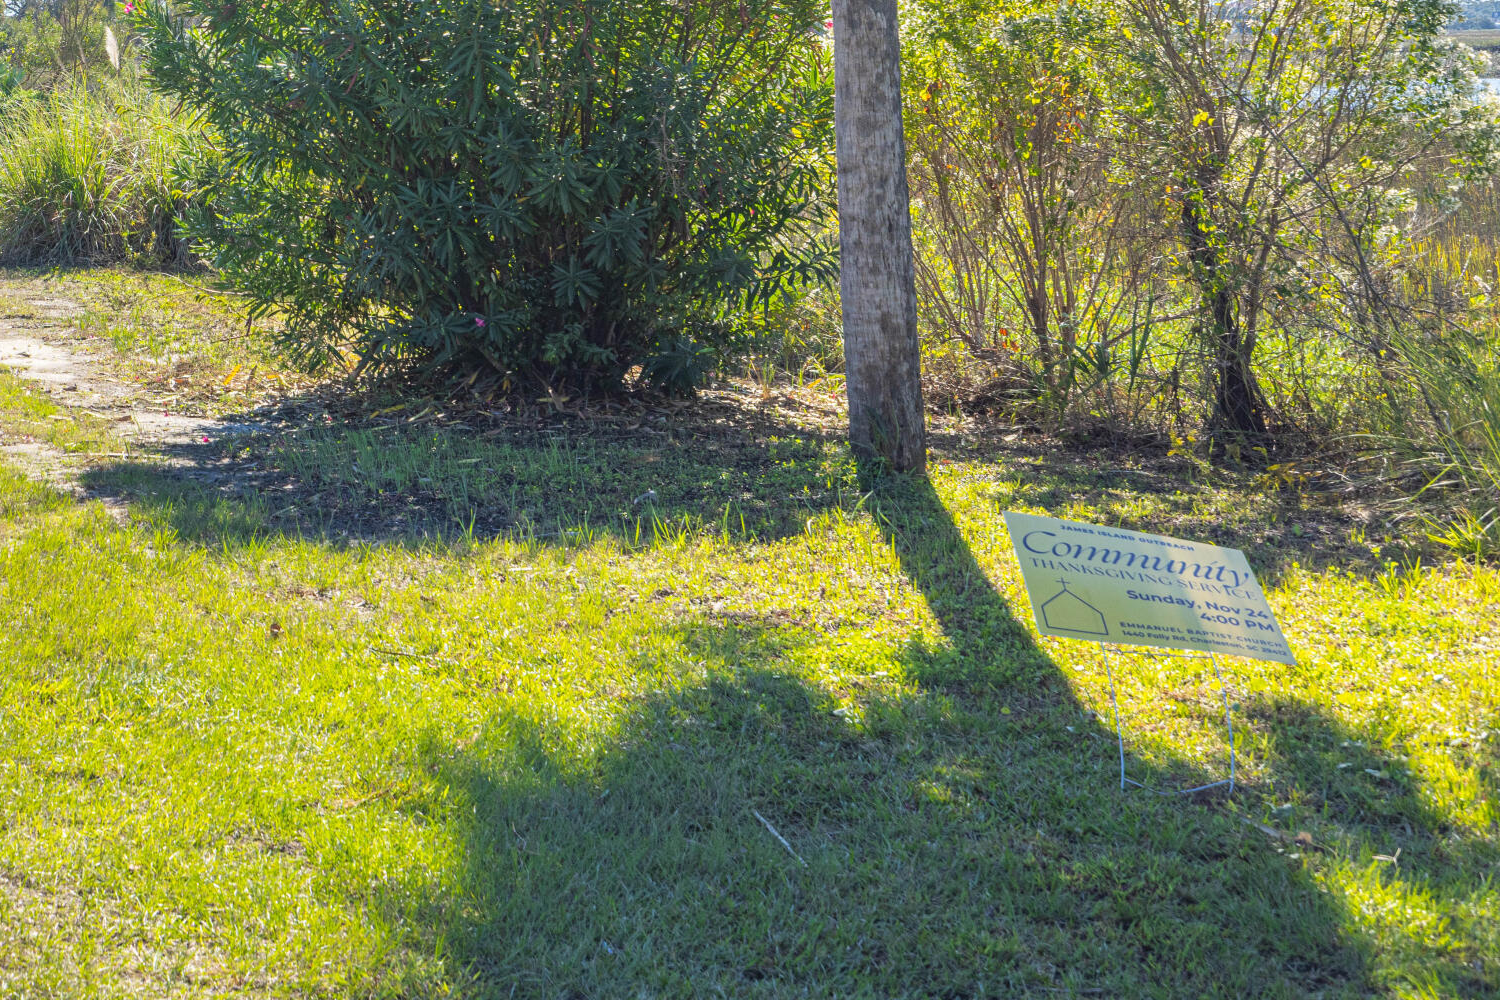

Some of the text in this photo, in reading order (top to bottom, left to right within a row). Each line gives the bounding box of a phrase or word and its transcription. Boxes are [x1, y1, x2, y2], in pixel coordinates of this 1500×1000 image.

[1060, 525, 1195, 551] JAMES ISLAND OUTREACH
[1022, 530, 1250, 588] Community
[1028, 556, 1258, 600] THANKSGIVING SERVICE
[1125, 589, 1269, 619] Sunday, Nov 24
[1118, 620, 1283, 647] EMMANUEL BAPTIST CHURCH
[1146, 632, 1171, 640] Folly
[1198, 613, 1275, 632] 4:00 PM
